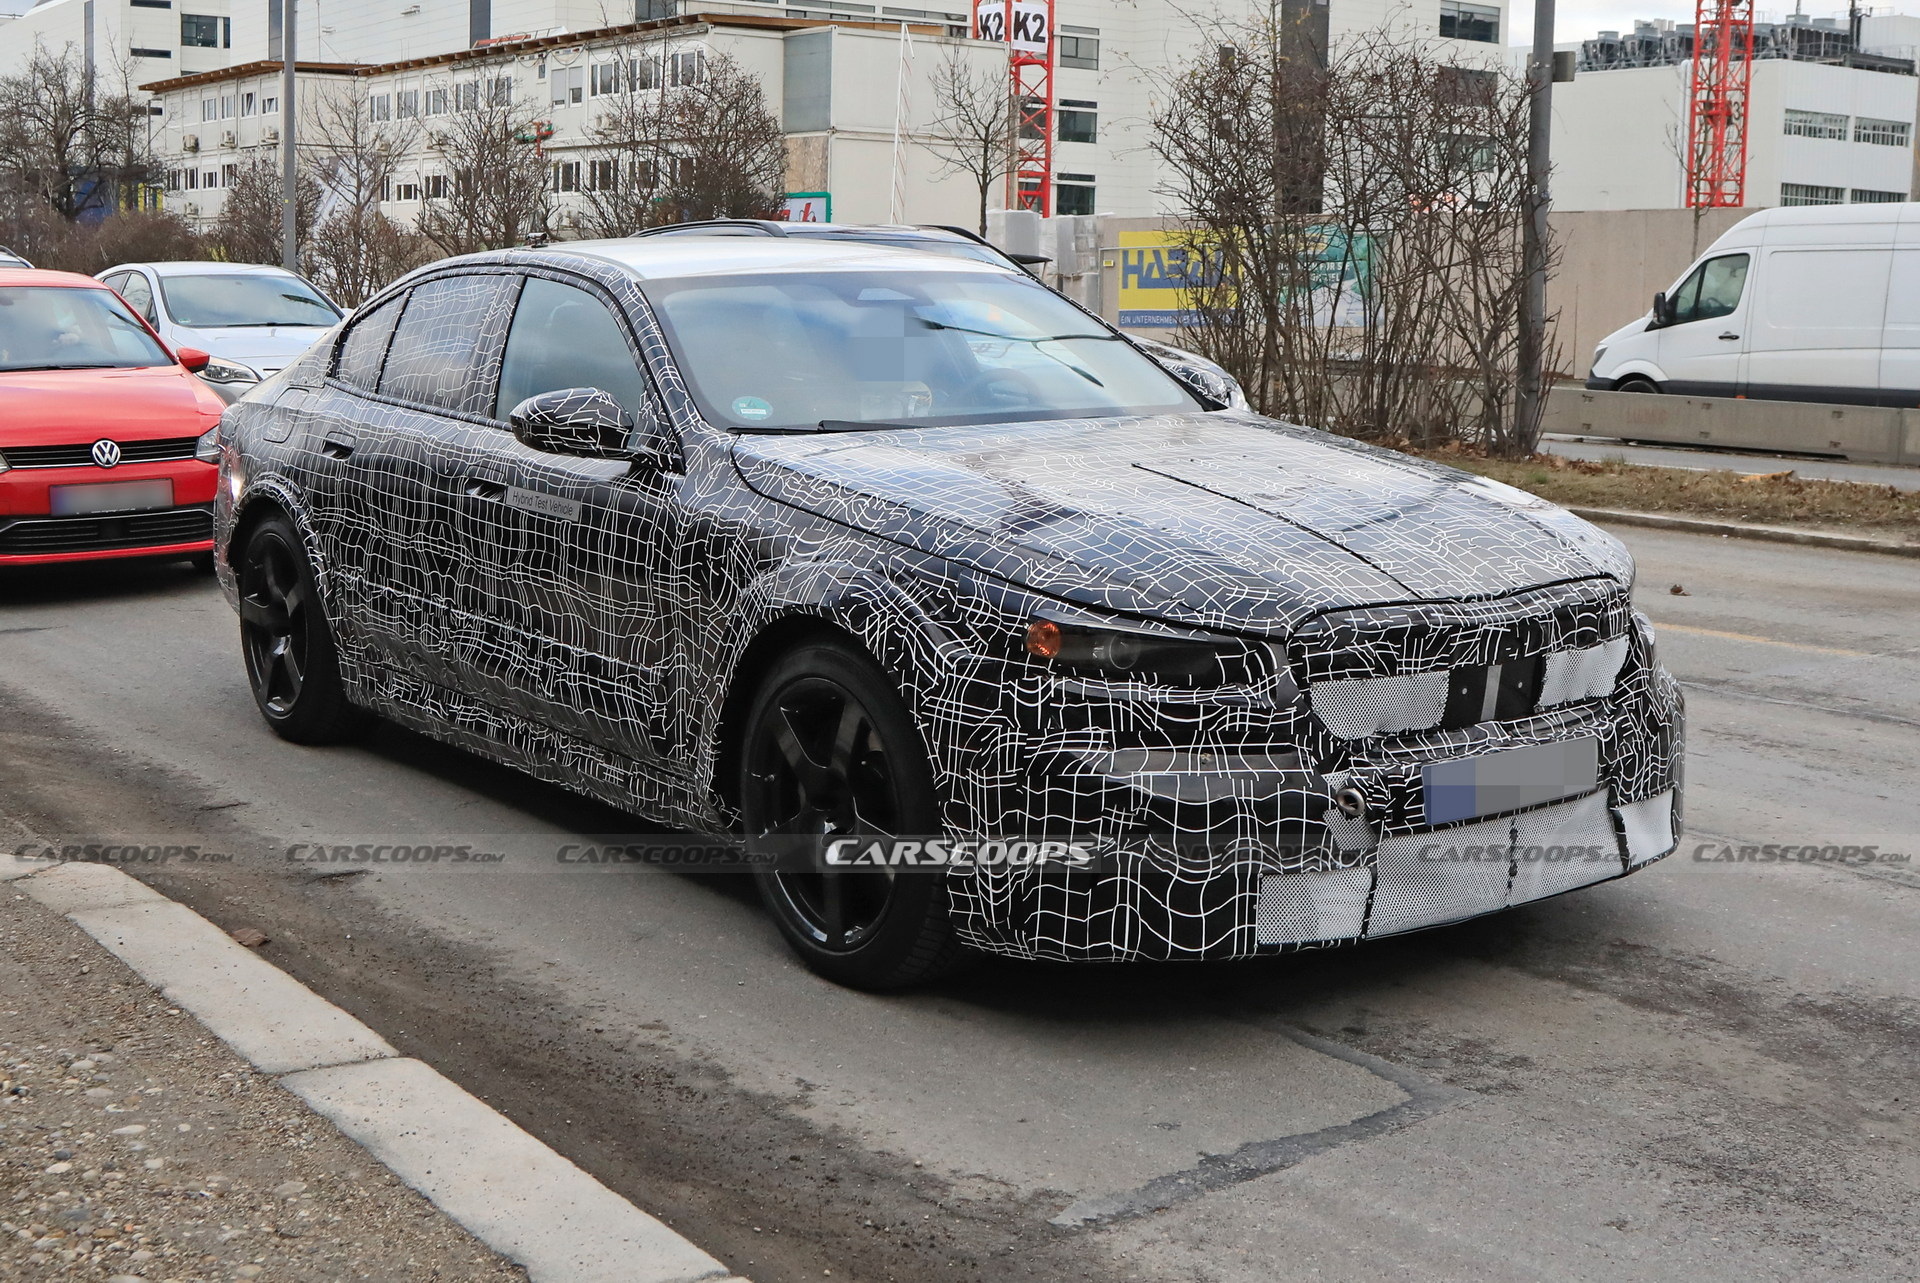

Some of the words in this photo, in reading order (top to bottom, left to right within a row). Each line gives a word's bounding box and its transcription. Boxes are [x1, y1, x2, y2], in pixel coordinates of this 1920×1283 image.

[980, 12, 1003, 40] K2
[1013, 11, 1046, 43] K2
[1120, 315, 1131, 324] EIN
[1132, 315, 1177, 325] UNTERNEHMEN
[512, 490, 533, 506] Hybrid
[535, 496, 548, 510] Test
[549, 499, 573, 516] Vehicle
